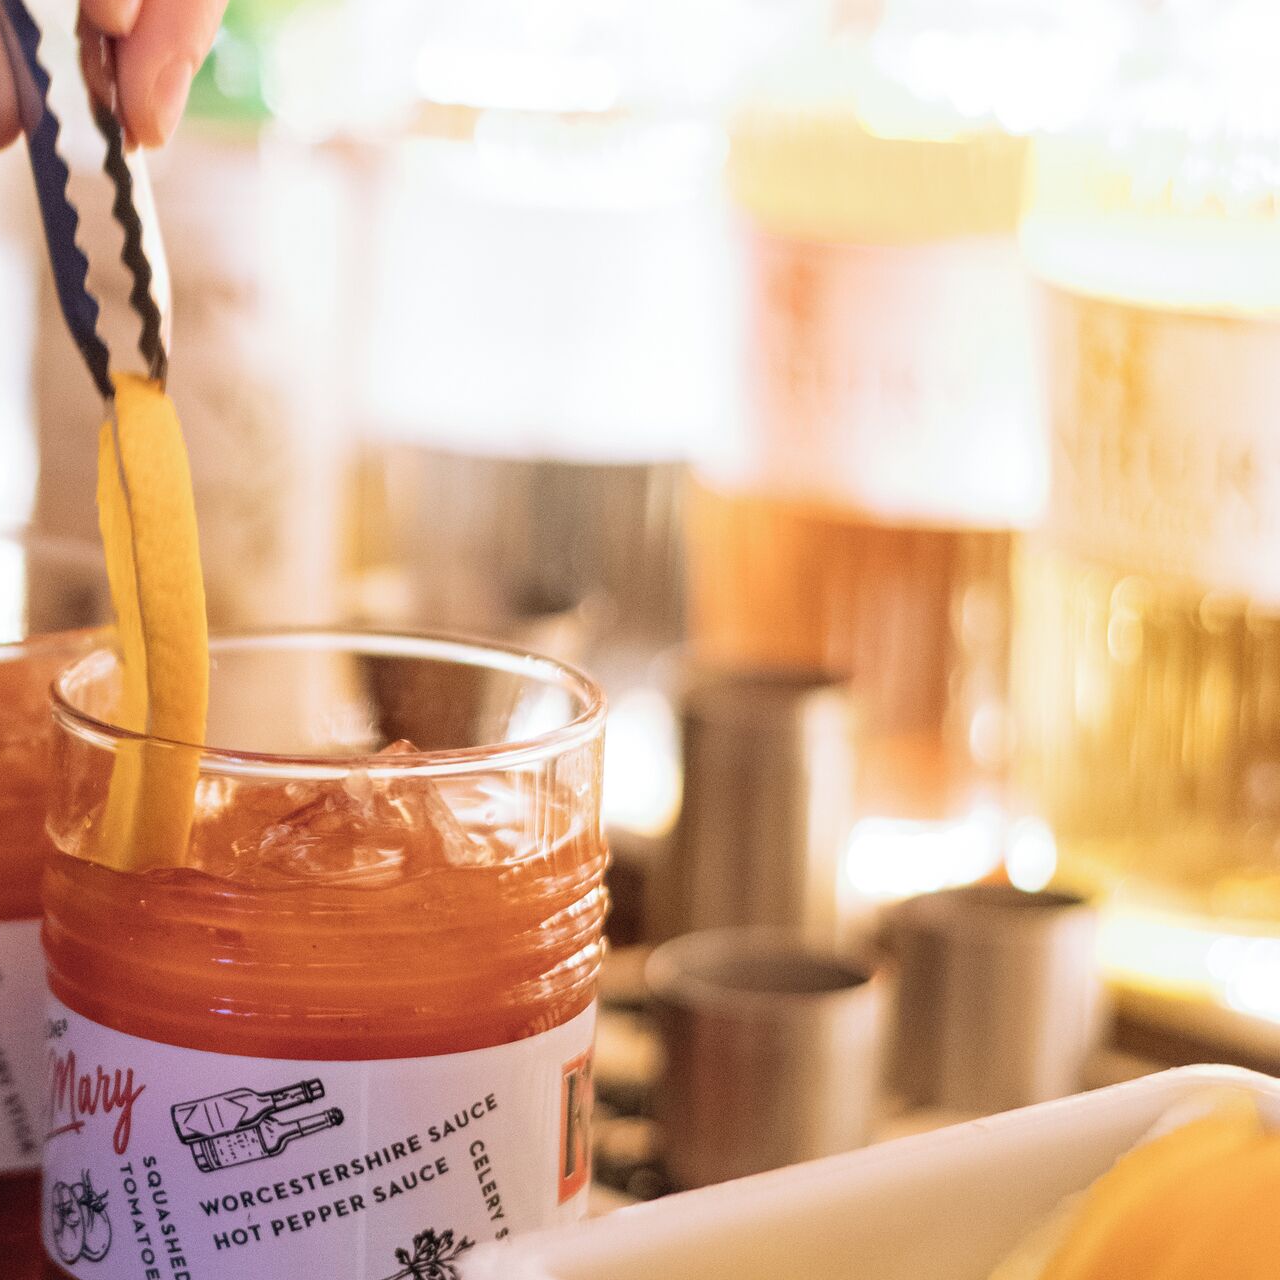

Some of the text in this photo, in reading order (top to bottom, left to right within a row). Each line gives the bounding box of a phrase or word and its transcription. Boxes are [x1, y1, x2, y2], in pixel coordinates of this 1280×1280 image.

[48, 1048, 147, 1156] Mary
[199, 1134, 423, 1218] WORCESTERSHIRE
[427, 1093, 499, 1144] SAUCE
[213, 1157, 450, 1251] HOT PEPPER SAUCE
[469, 1139, 505, 1221] CELERY
